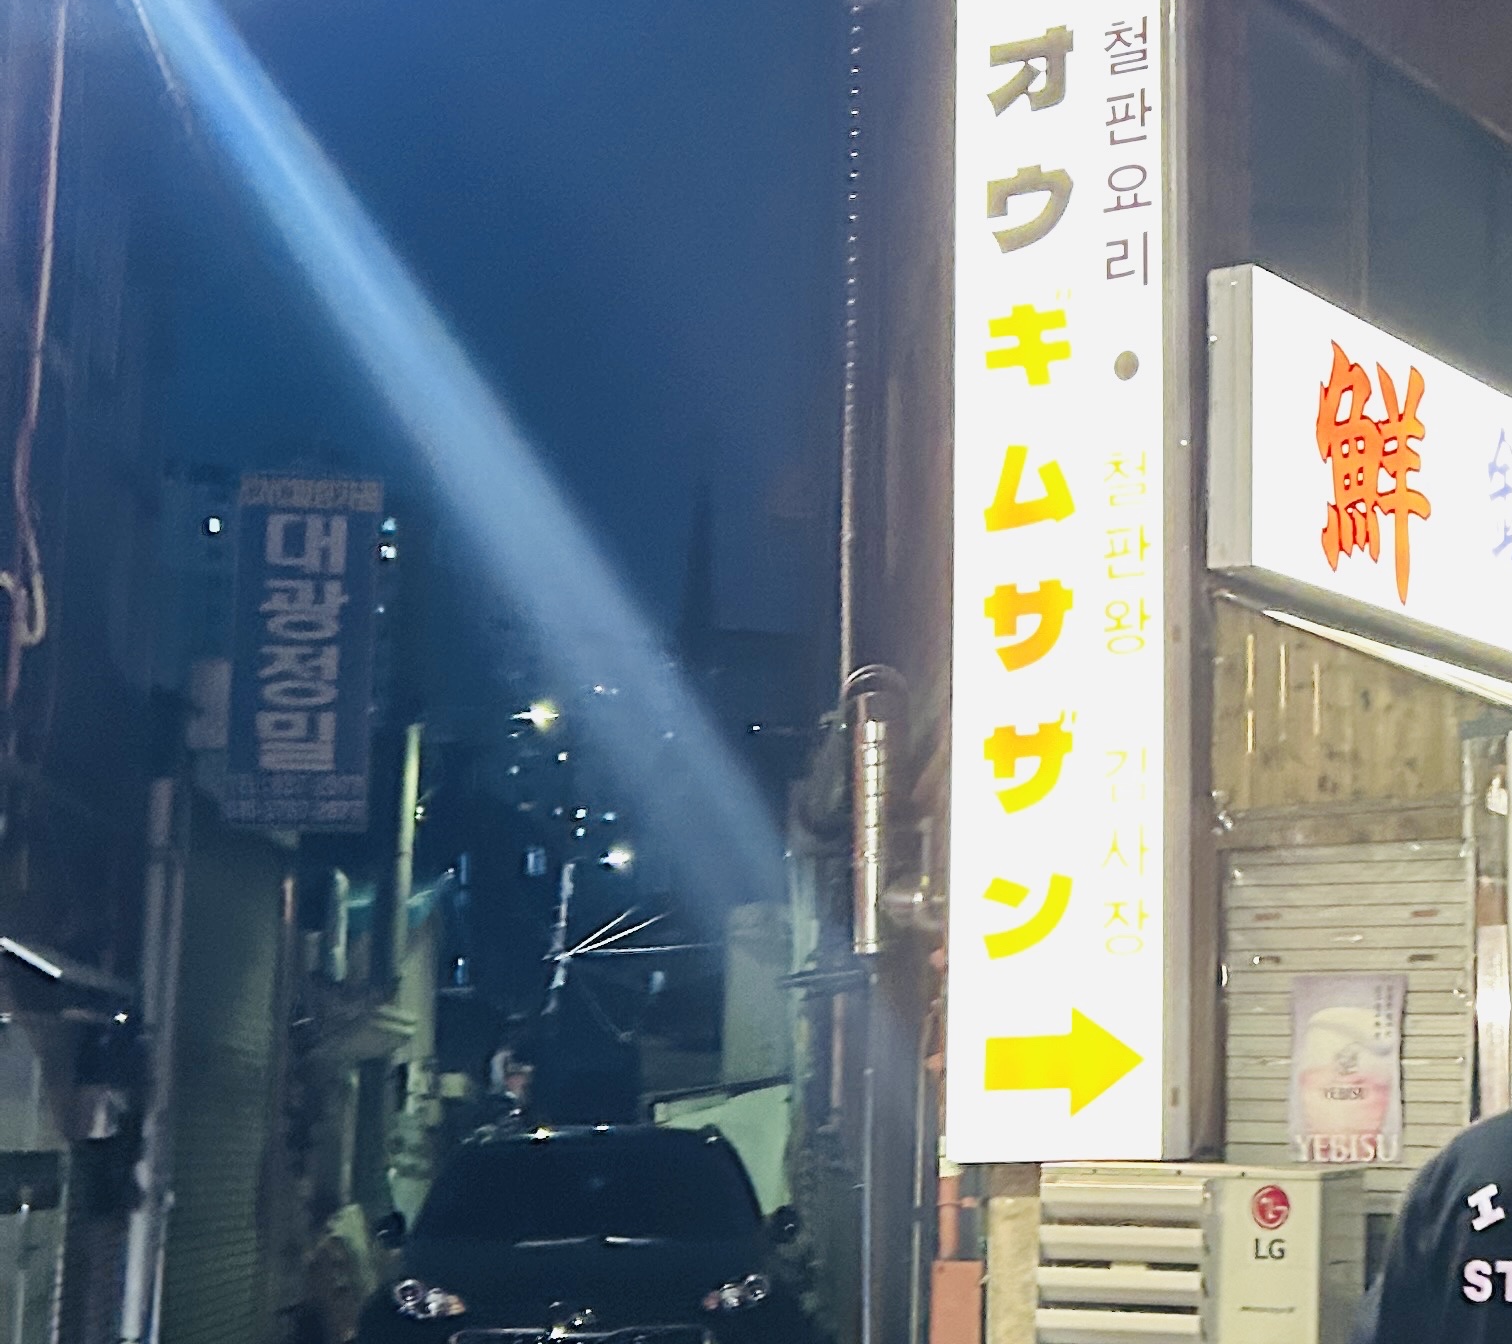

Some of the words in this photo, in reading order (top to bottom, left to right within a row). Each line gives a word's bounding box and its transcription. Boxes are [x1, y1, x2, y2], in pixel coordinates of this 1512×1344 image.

[1103, 16, 1152, 286] 철판요리
[1103, 451, 1152, 655] 철판왕
[1316, 339, 1431, 605] 鮮
[1254, 1238, 1285, 1260] LG
[1295, 1134, 1398, 1162] YEBISU
